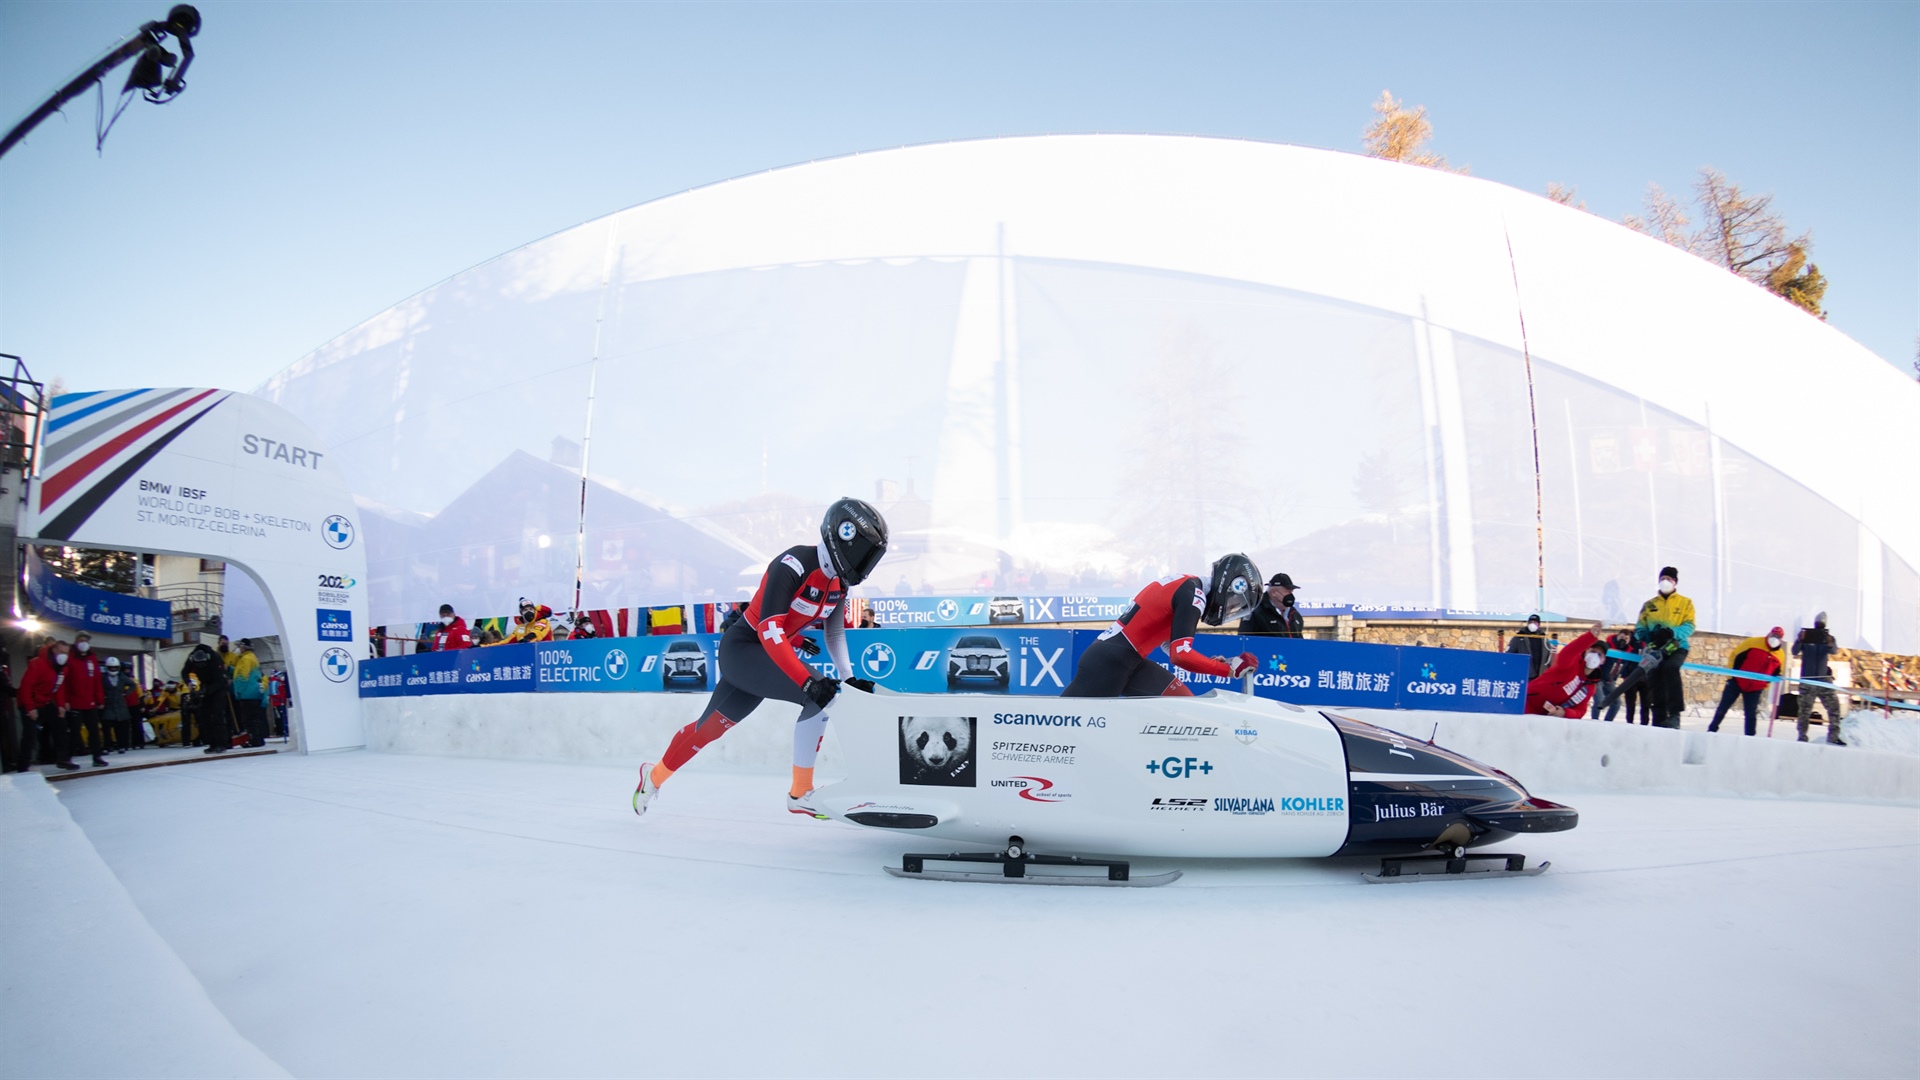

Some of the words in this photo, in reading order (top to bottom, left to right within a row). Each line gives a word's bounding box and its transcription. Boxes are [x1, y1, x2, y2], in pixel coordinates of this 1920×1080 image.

[242, 433, 324, 470] START
[139, 480, 172, 495] BMW
[178, 486, 207, 500] IBSF
[137, 495, 184, 512] WORLD
[186, 502, 212, 515] CUP
[214, 506, 240, 520] BOB
[253, 513, 311, 533] SKELETON
[842, 503, 858, 519] Julius
[137, 510, 155, 523] ST.
[158, 513, 267, 538] MORITZ-CELERINA
[872, 599, 909, 613] 100%
[1029, 597, 1055, 620] iX
[1062, 604, 1126, 618] ELECTRIC
[91, 612, 121, 626] caissa
[874, 610, 936, 625] ELECTRIC
[1018, 636, 1039, 647] THE
[539, 650, 573, 666] 100%
[540, 665, 601, 682] ELECTRIC
[1019, 647, 1065, 687] iX
[360, 679, 377, 689] caissa
[407, 676, 427, 686] caissa
[465, 672, 491, 683] caissa
[1253, 673, 1312, 689] caissa
[1317, 669, 1391, 693] 凯撒旅游
[1406, 681, 1457, 696] caissa
[1461, 677, 1521, 699] 凯撒旅游
[1086, 716, 1107, 728] AG
[1139, 722, 1219, 737] icerunner
[992, 741, 1077, 755] SPITZENSPORT
[991, 752, 1042, 763] SCHWEIZER
[1042, 755, 1076, 765] ARMEE
[1146, 756, 1214, 779] +GF+
[991, 780, 1028, 788] UNITED
[1152, 798, 1208, 806] LS2
[1214, 797, 1275, 812] SILVAPLANA
[1281, 797, 1345, 811] KOHLER
[1374, 803, 1416, 823] Julius
[1420, 802, 1445, 817] Bär
